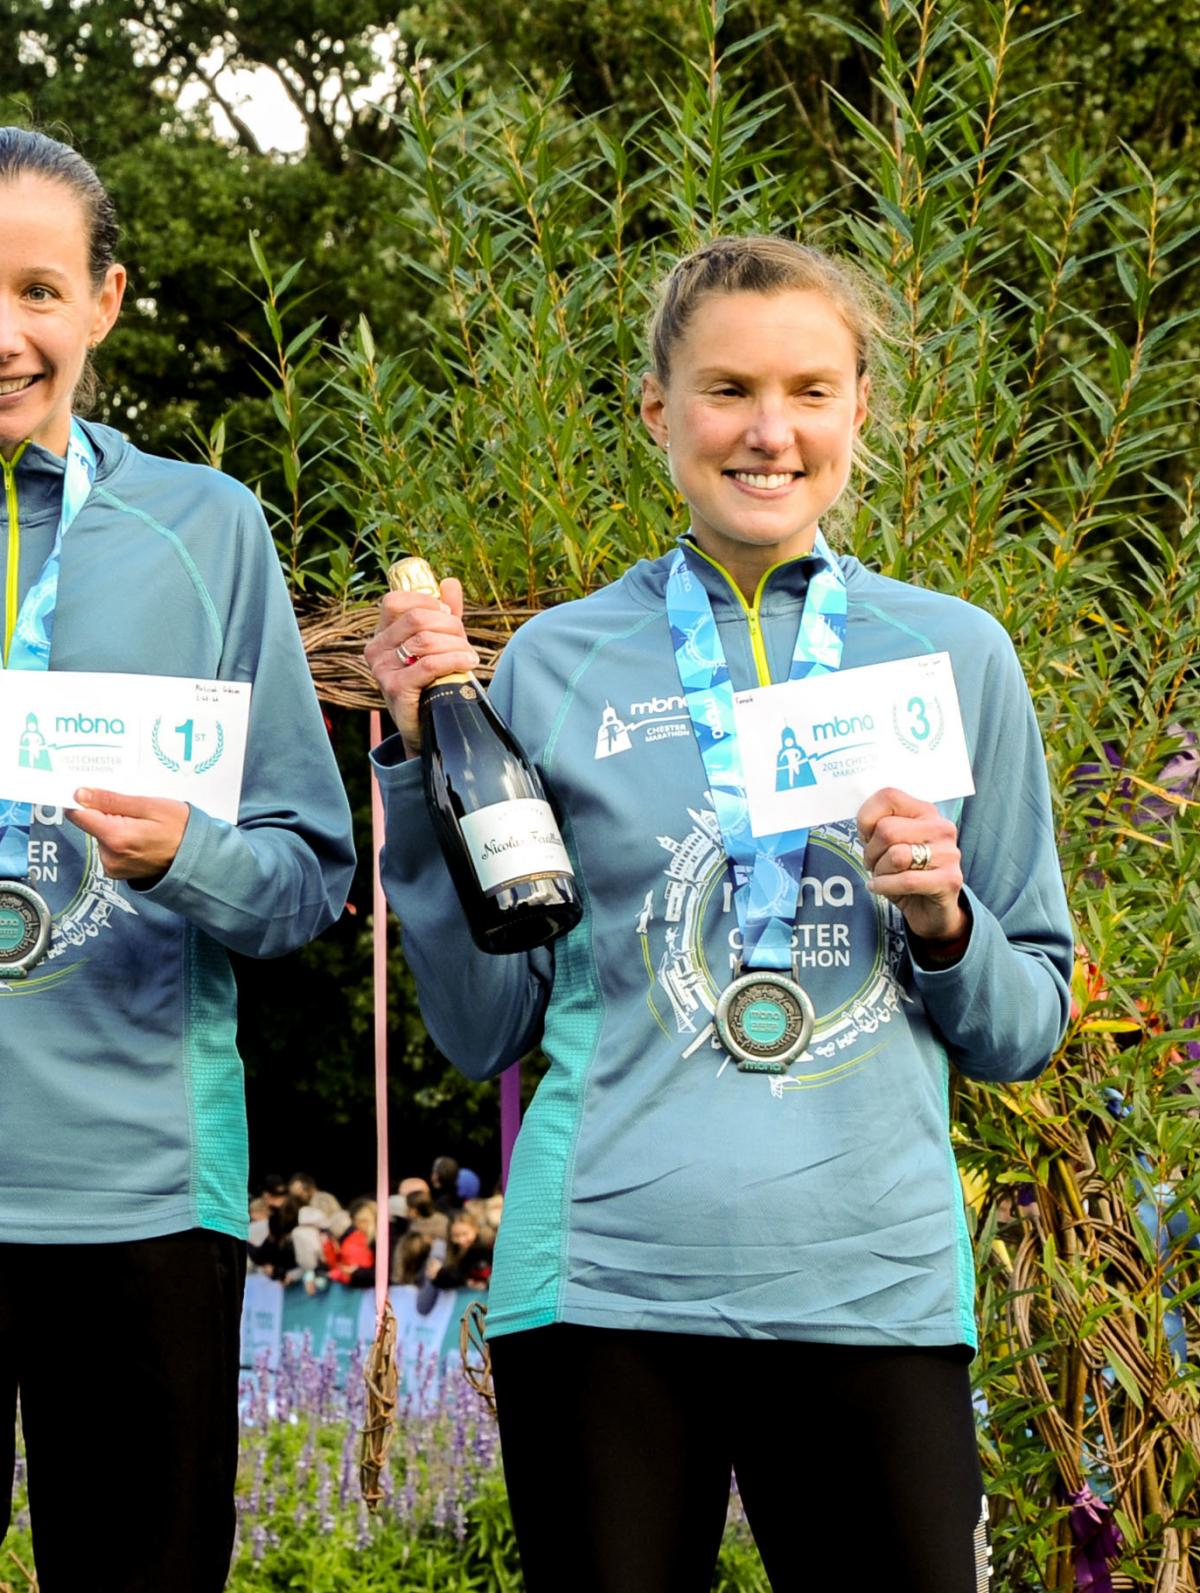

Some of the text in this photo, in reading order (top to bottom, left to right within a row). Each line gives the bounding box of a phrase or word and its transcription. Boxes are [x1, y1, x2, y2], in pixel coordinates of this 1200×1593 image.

[55, 713, 125, 735] mbna
[812, 704, 875, 741] mbna
[907, 696, 931, 740] 3
